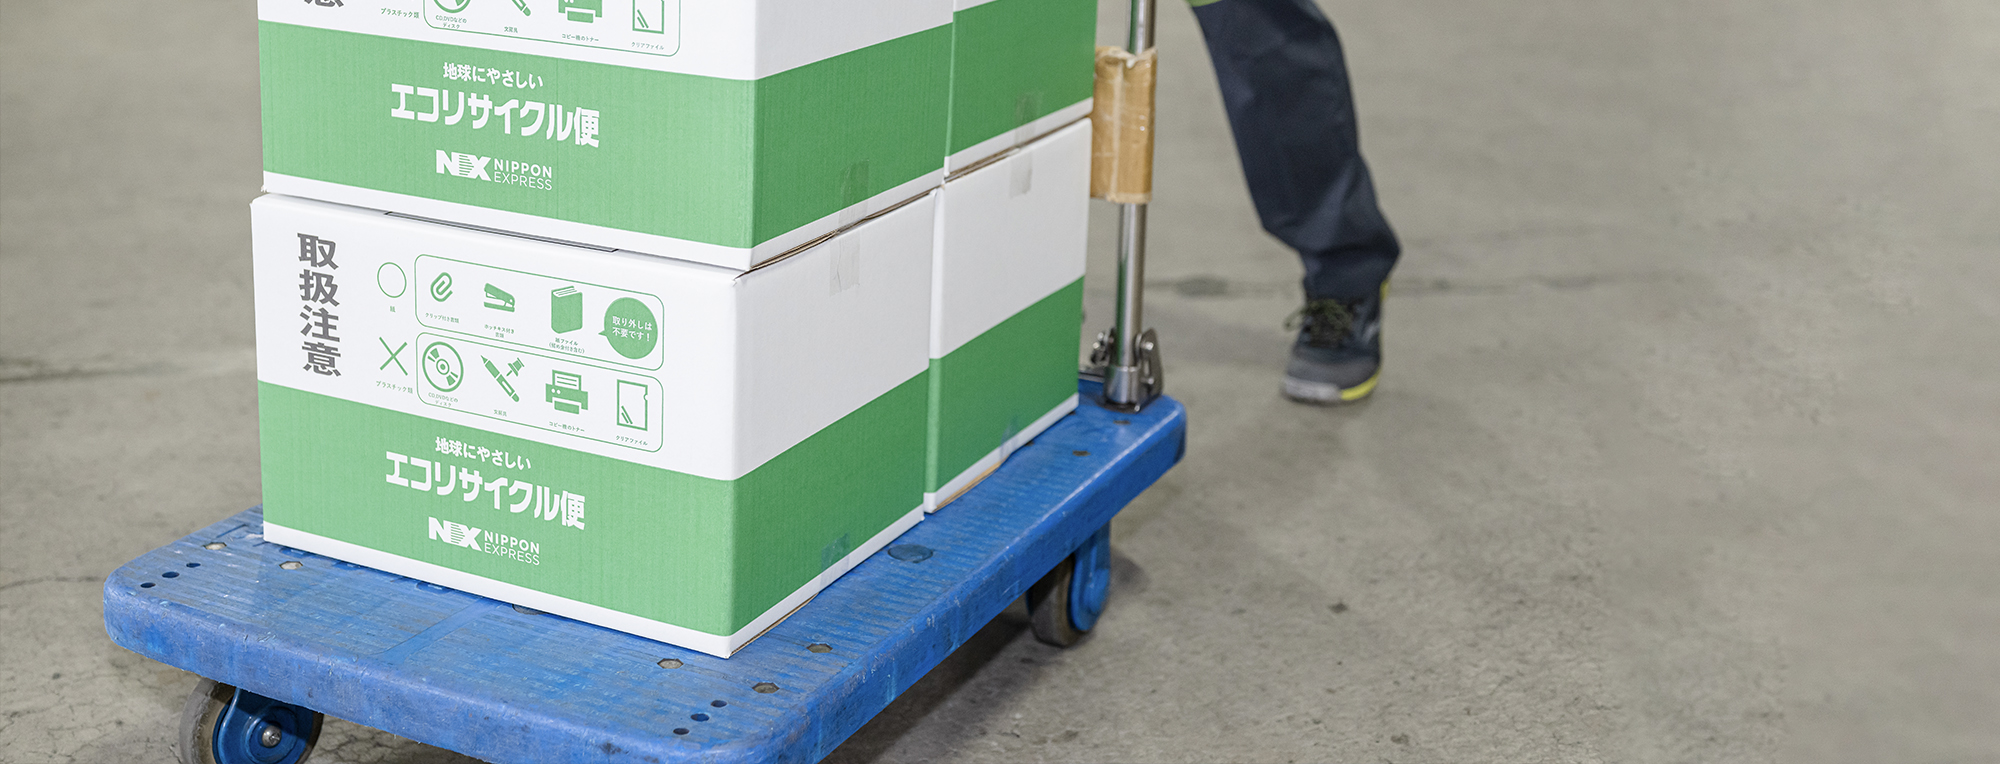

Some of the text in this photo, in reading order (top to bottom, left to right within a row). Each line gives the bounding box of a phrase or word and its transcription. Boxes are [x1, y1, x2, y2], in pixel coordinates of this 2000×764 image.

[443, 62, 544, 89] 地球にやさしい
[391, 83, 600, 148] エコリサイクル便
[494, 158, 552, 179] NIPPON
[494, 172, 553, 191] EXPRESS
[297, 232, 342, 377] 取扱注意
[612, 316, 653, 331] 取り外しは
[435, 436, 532, 470] 地球にやさしい
[386, 451, 586, 530] エコリサイクル便
[484, 530, 540, 555] NIPPON
[484, 543, 540, 566] EXPRESS
